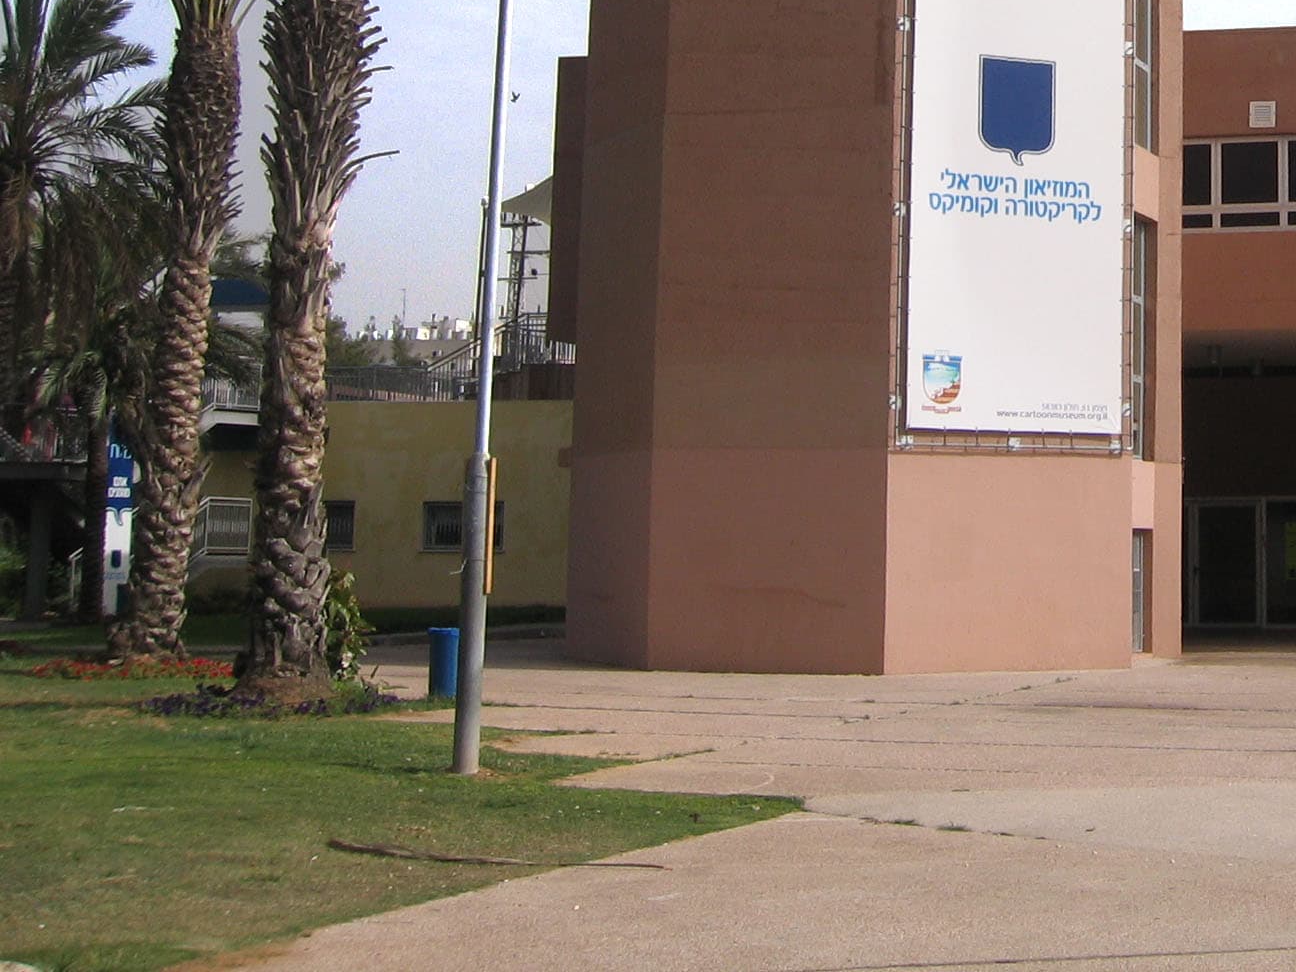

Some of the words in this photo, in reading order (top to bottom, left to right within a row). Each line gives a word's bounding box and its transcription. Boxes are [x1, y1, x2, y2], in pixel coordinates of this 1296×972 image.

[941, 169, 1017, 193] הישראלי
[1024, 178, 1090, 199] המוזיאון
[929, 193, 998, 217] וקומיקס
[1005, 199, 1102, 223] לקריקטורה
